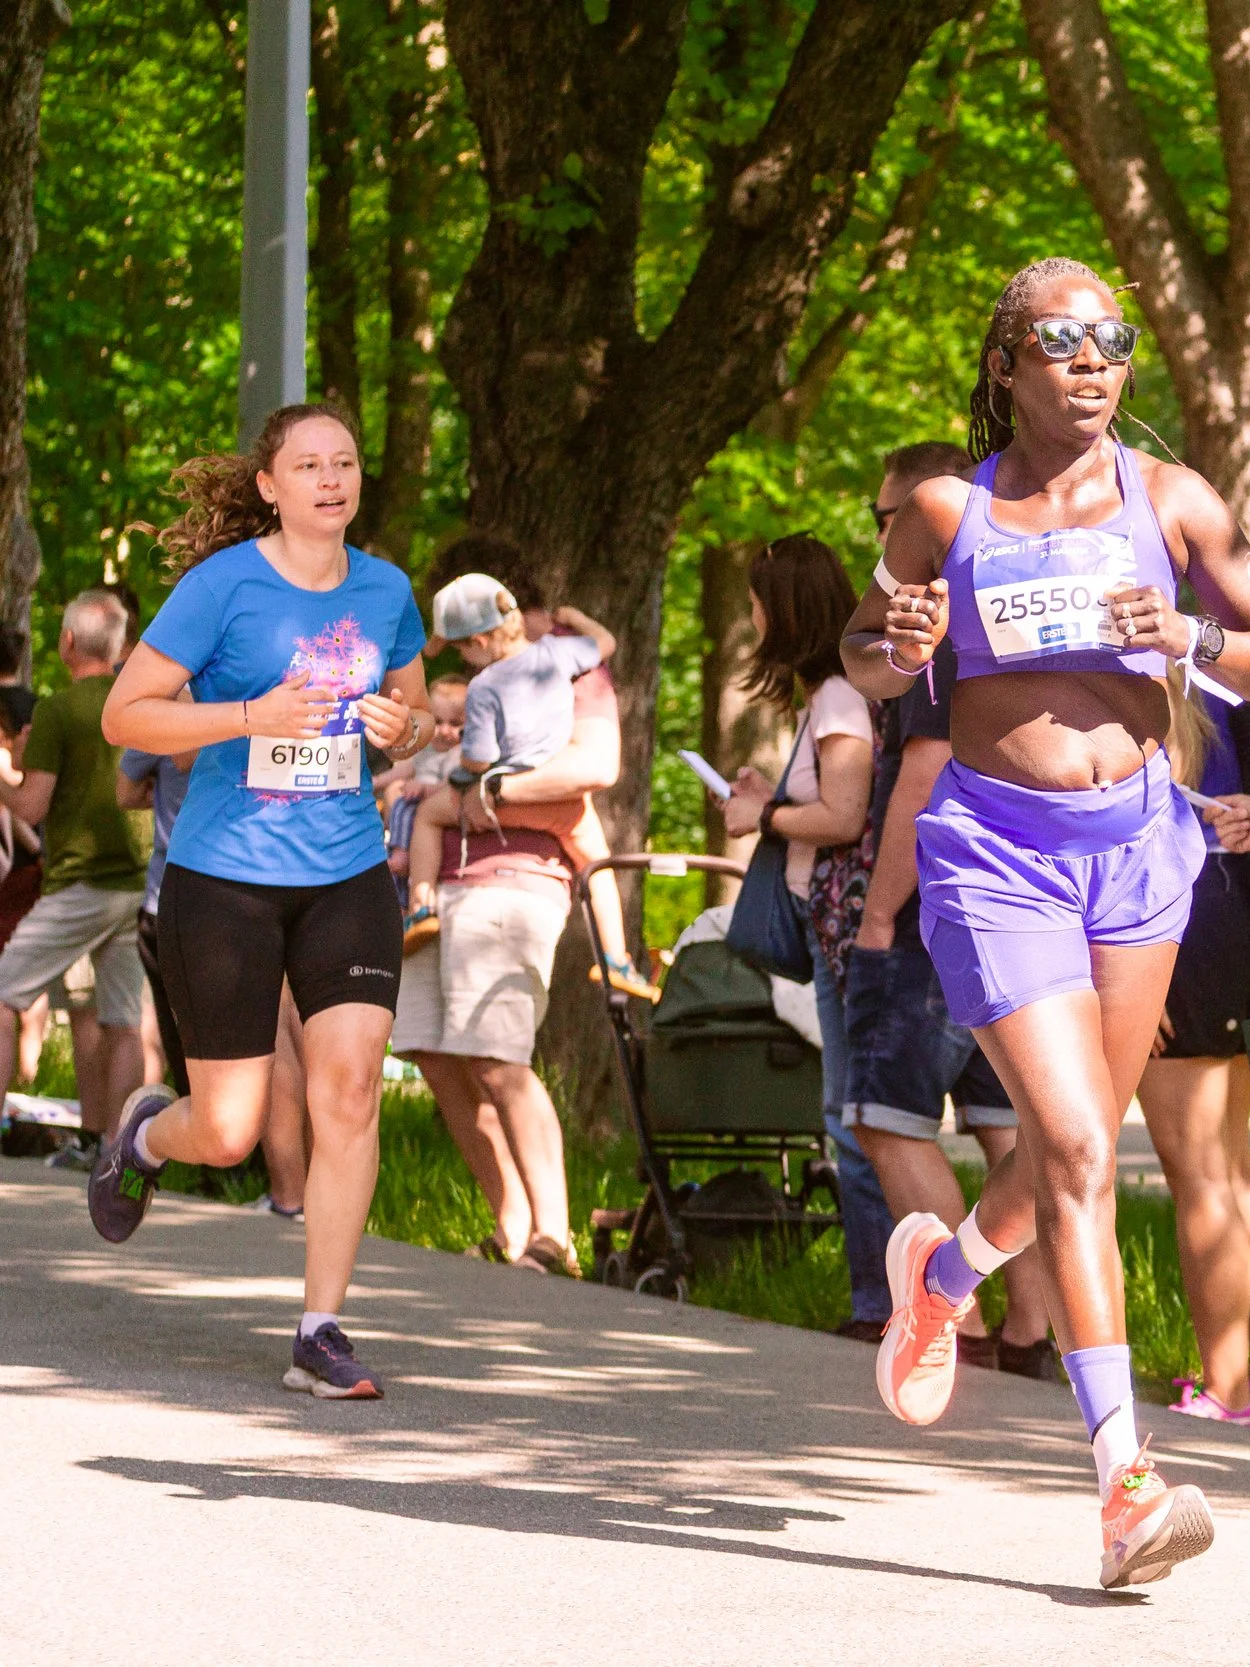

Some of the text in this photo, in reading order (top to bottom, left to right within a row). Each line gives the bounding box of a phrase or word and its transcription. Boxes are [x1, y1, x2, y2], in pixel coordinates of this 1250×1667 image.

[990, 586, 1091, 624] 25550
[1042, 628, 1066, 639] ERSTE
[271, 745, 330, 766] 6190
